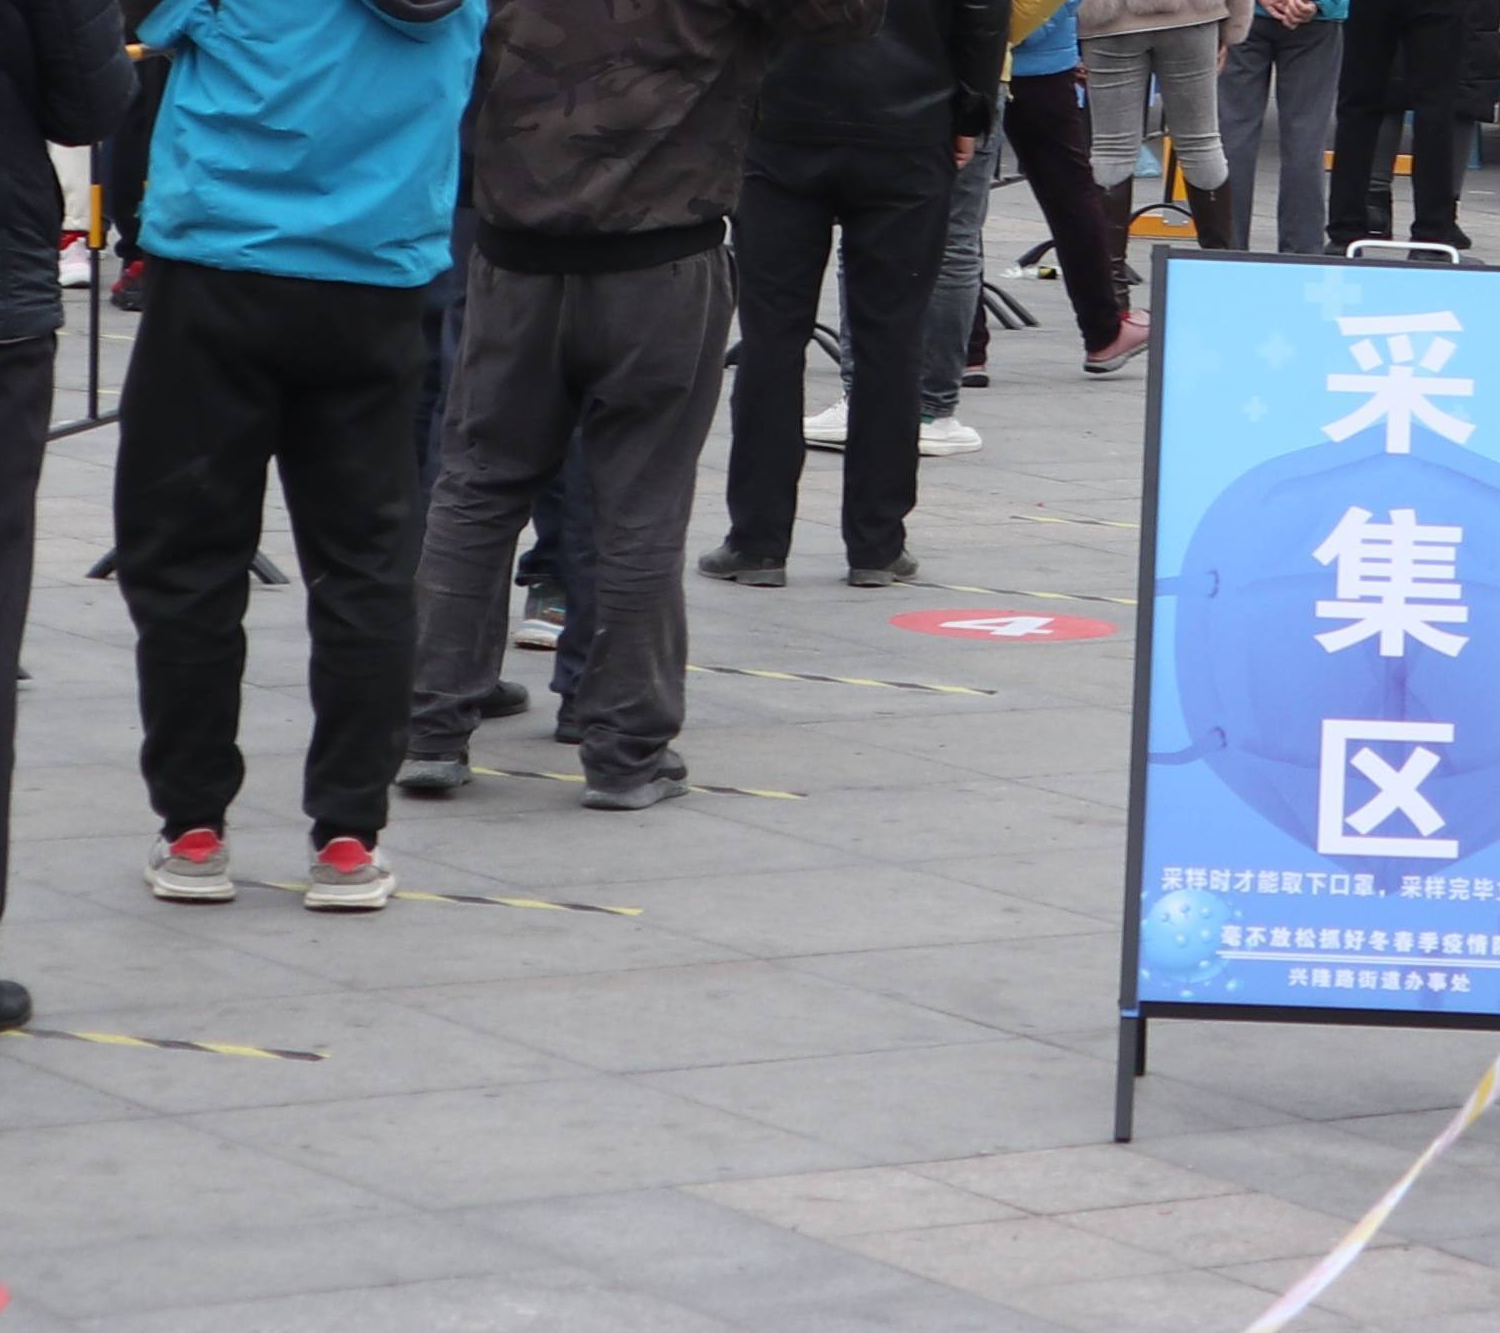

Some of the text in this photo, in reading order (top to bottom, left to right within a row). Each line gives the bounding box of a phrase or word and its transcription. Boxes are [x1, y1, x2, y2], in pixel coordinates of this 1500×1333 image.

[1312, 309, 1478, 860] 采集区
[937, 616, 1056, 637] 4
[1288, 968, 1472, 993] 兴隆路街道办事处
